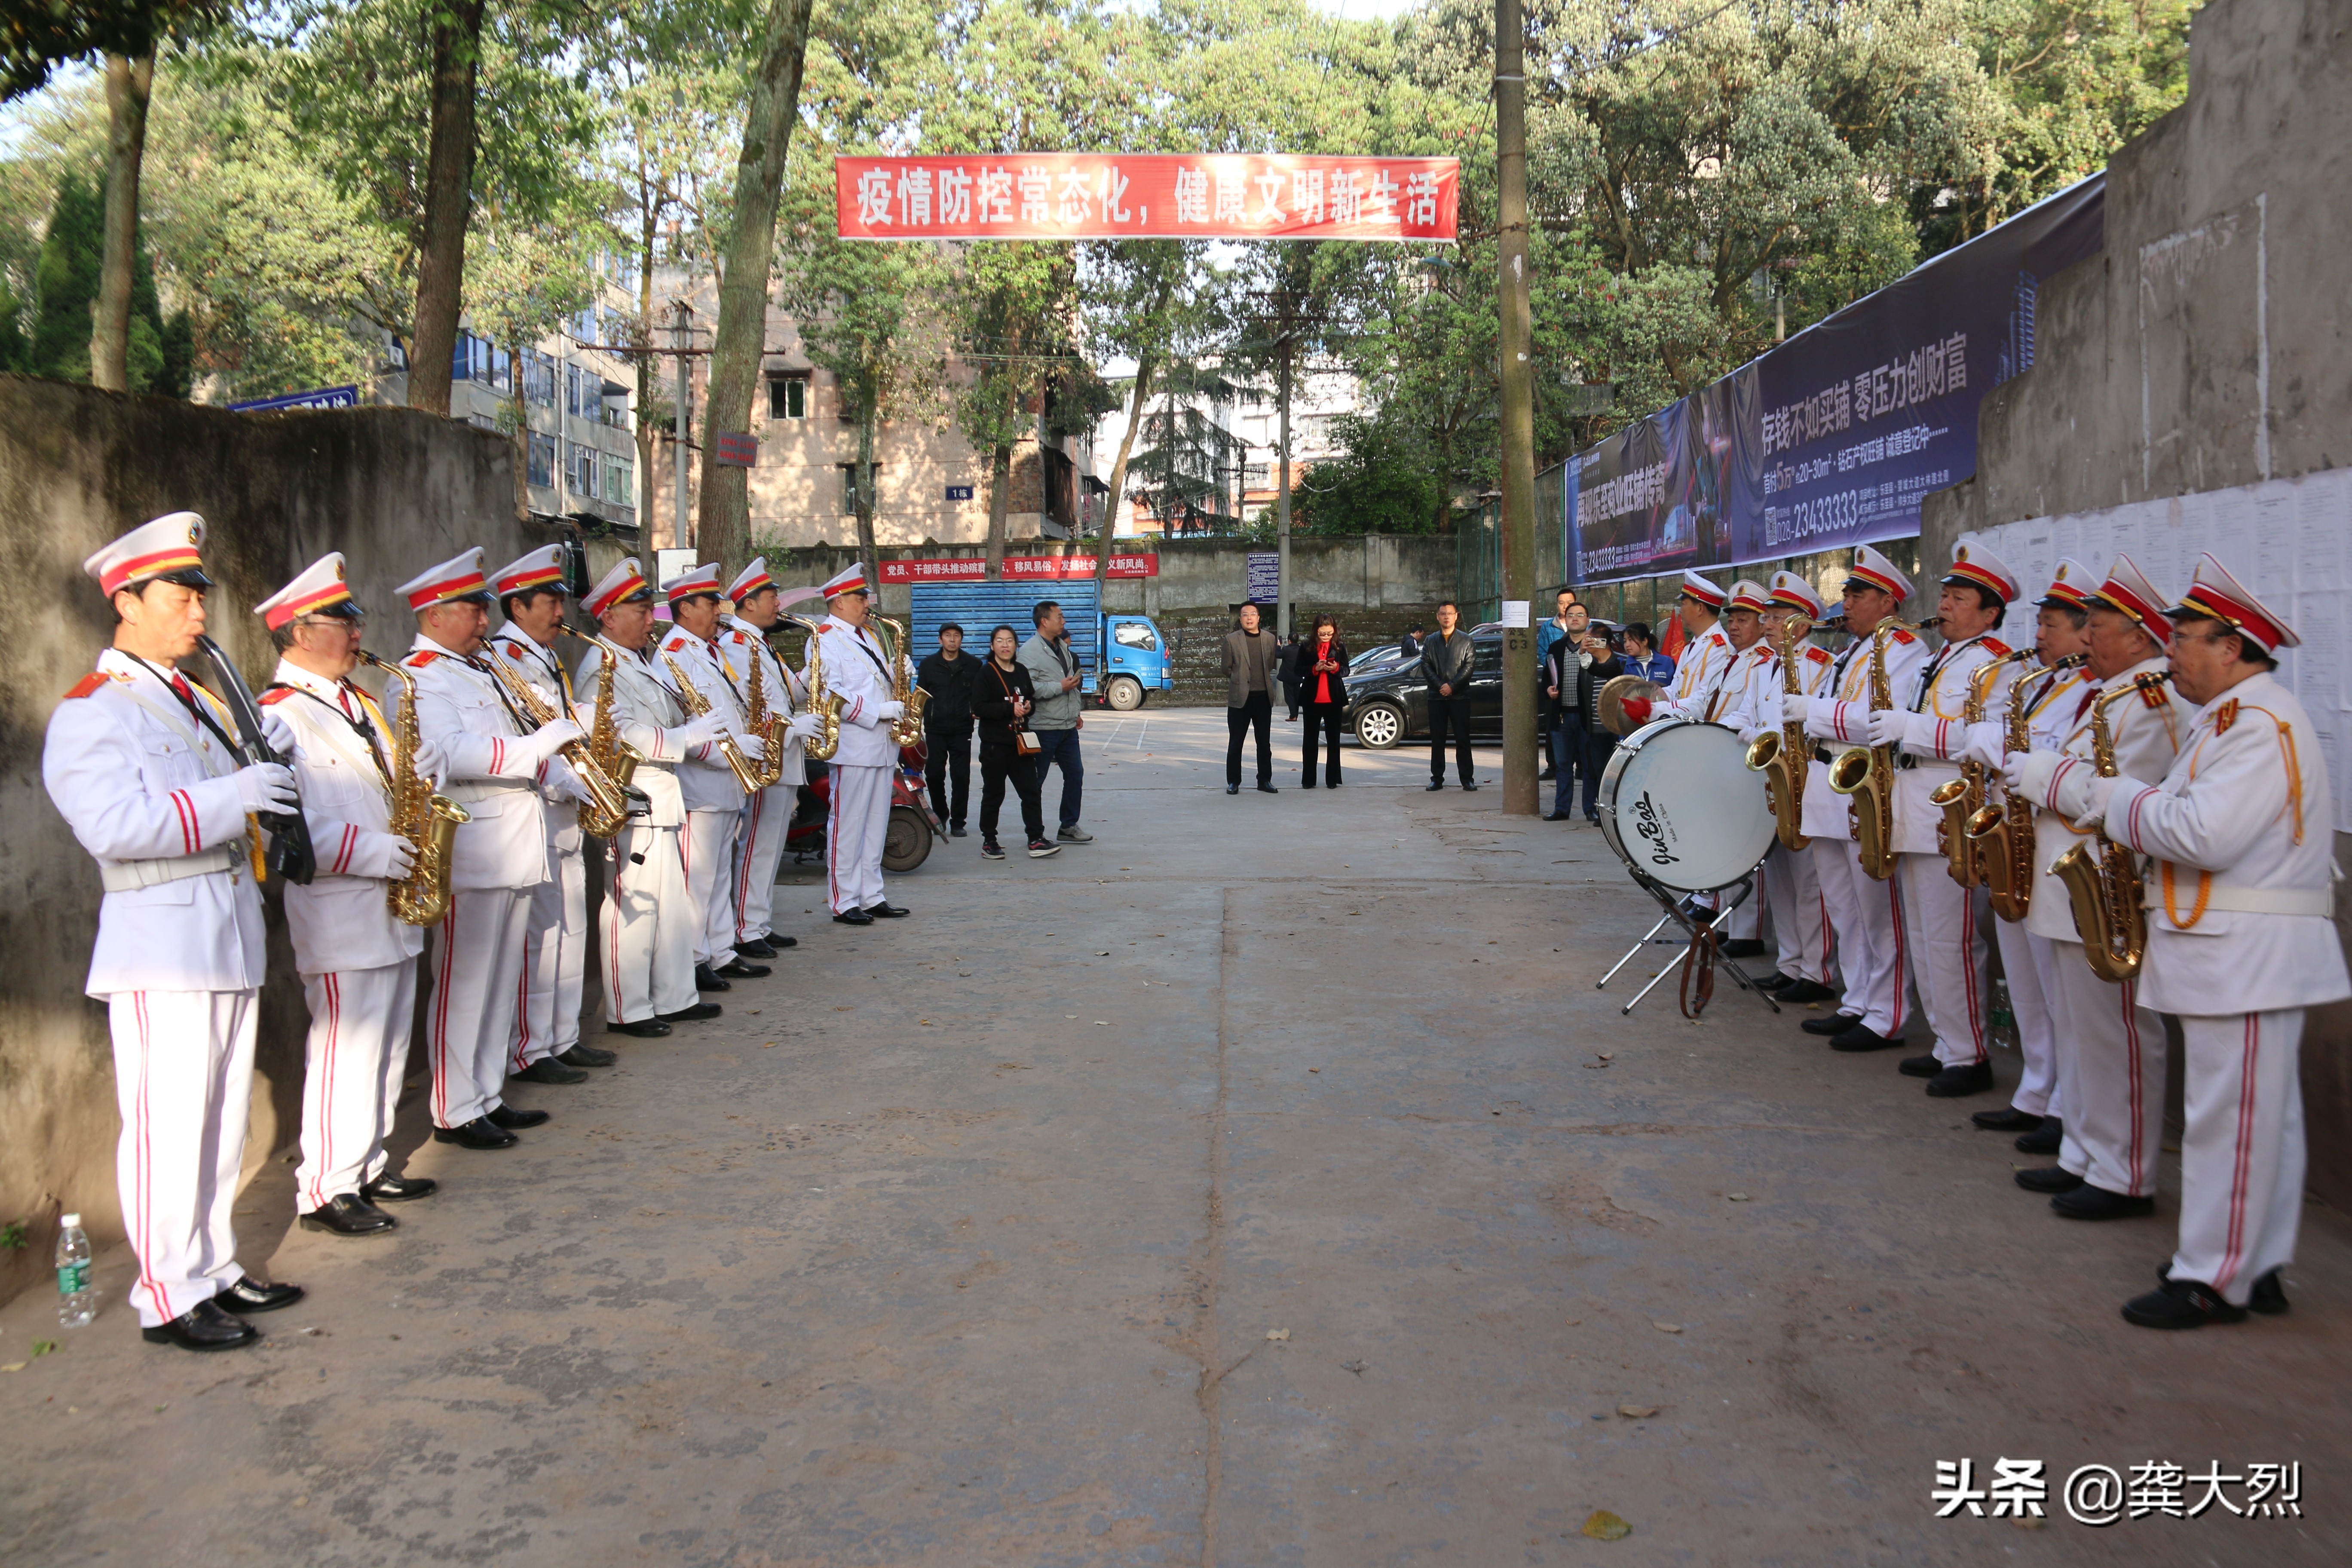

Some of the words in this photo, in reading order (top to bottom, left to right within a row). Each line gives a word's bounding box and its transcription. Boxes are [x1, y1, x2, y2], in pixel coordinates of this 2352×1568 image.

[858, 165, 1439, 226] 疫情防控常态化，健康文明新生活
[1761, 380, 1850, 456] 存钱不如买铺
[1855, 331, 1967, 422] 零压力创财富
[952, 489, 968, 497] 1栋
[1777, 489, 1857, 542] 028-23433333
[887, 558, 1148, 576] 党员、干部带头推动殡葬，移风易俗，发扬社会义新风尚。
